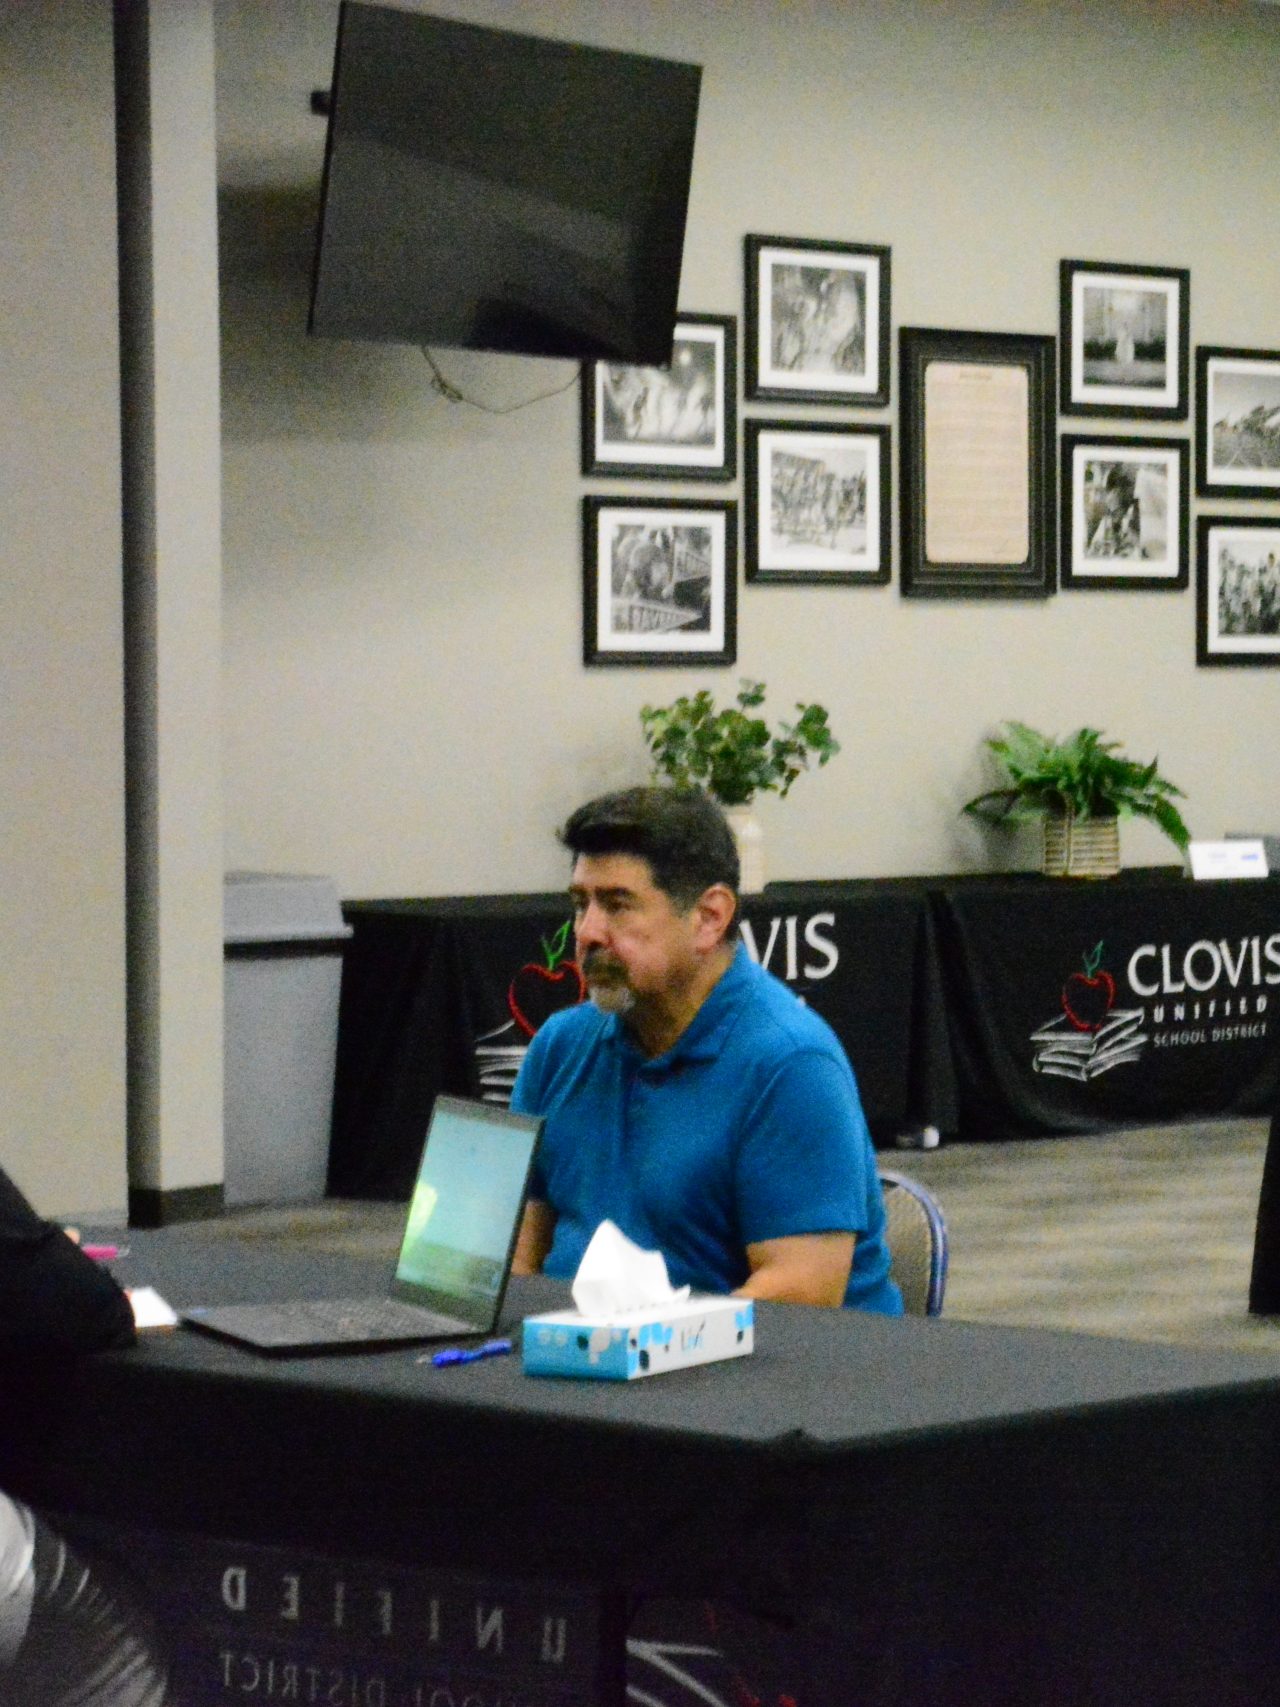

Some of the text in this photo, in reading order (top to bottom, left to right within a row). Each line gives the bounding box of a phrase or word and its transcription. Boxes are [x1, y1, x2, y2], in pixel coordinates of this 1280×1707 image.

[1153, 994, 1268, 1024] UNIFIED
[1153, 1022, 1267, 1048] SCHOOL DISTRICT
